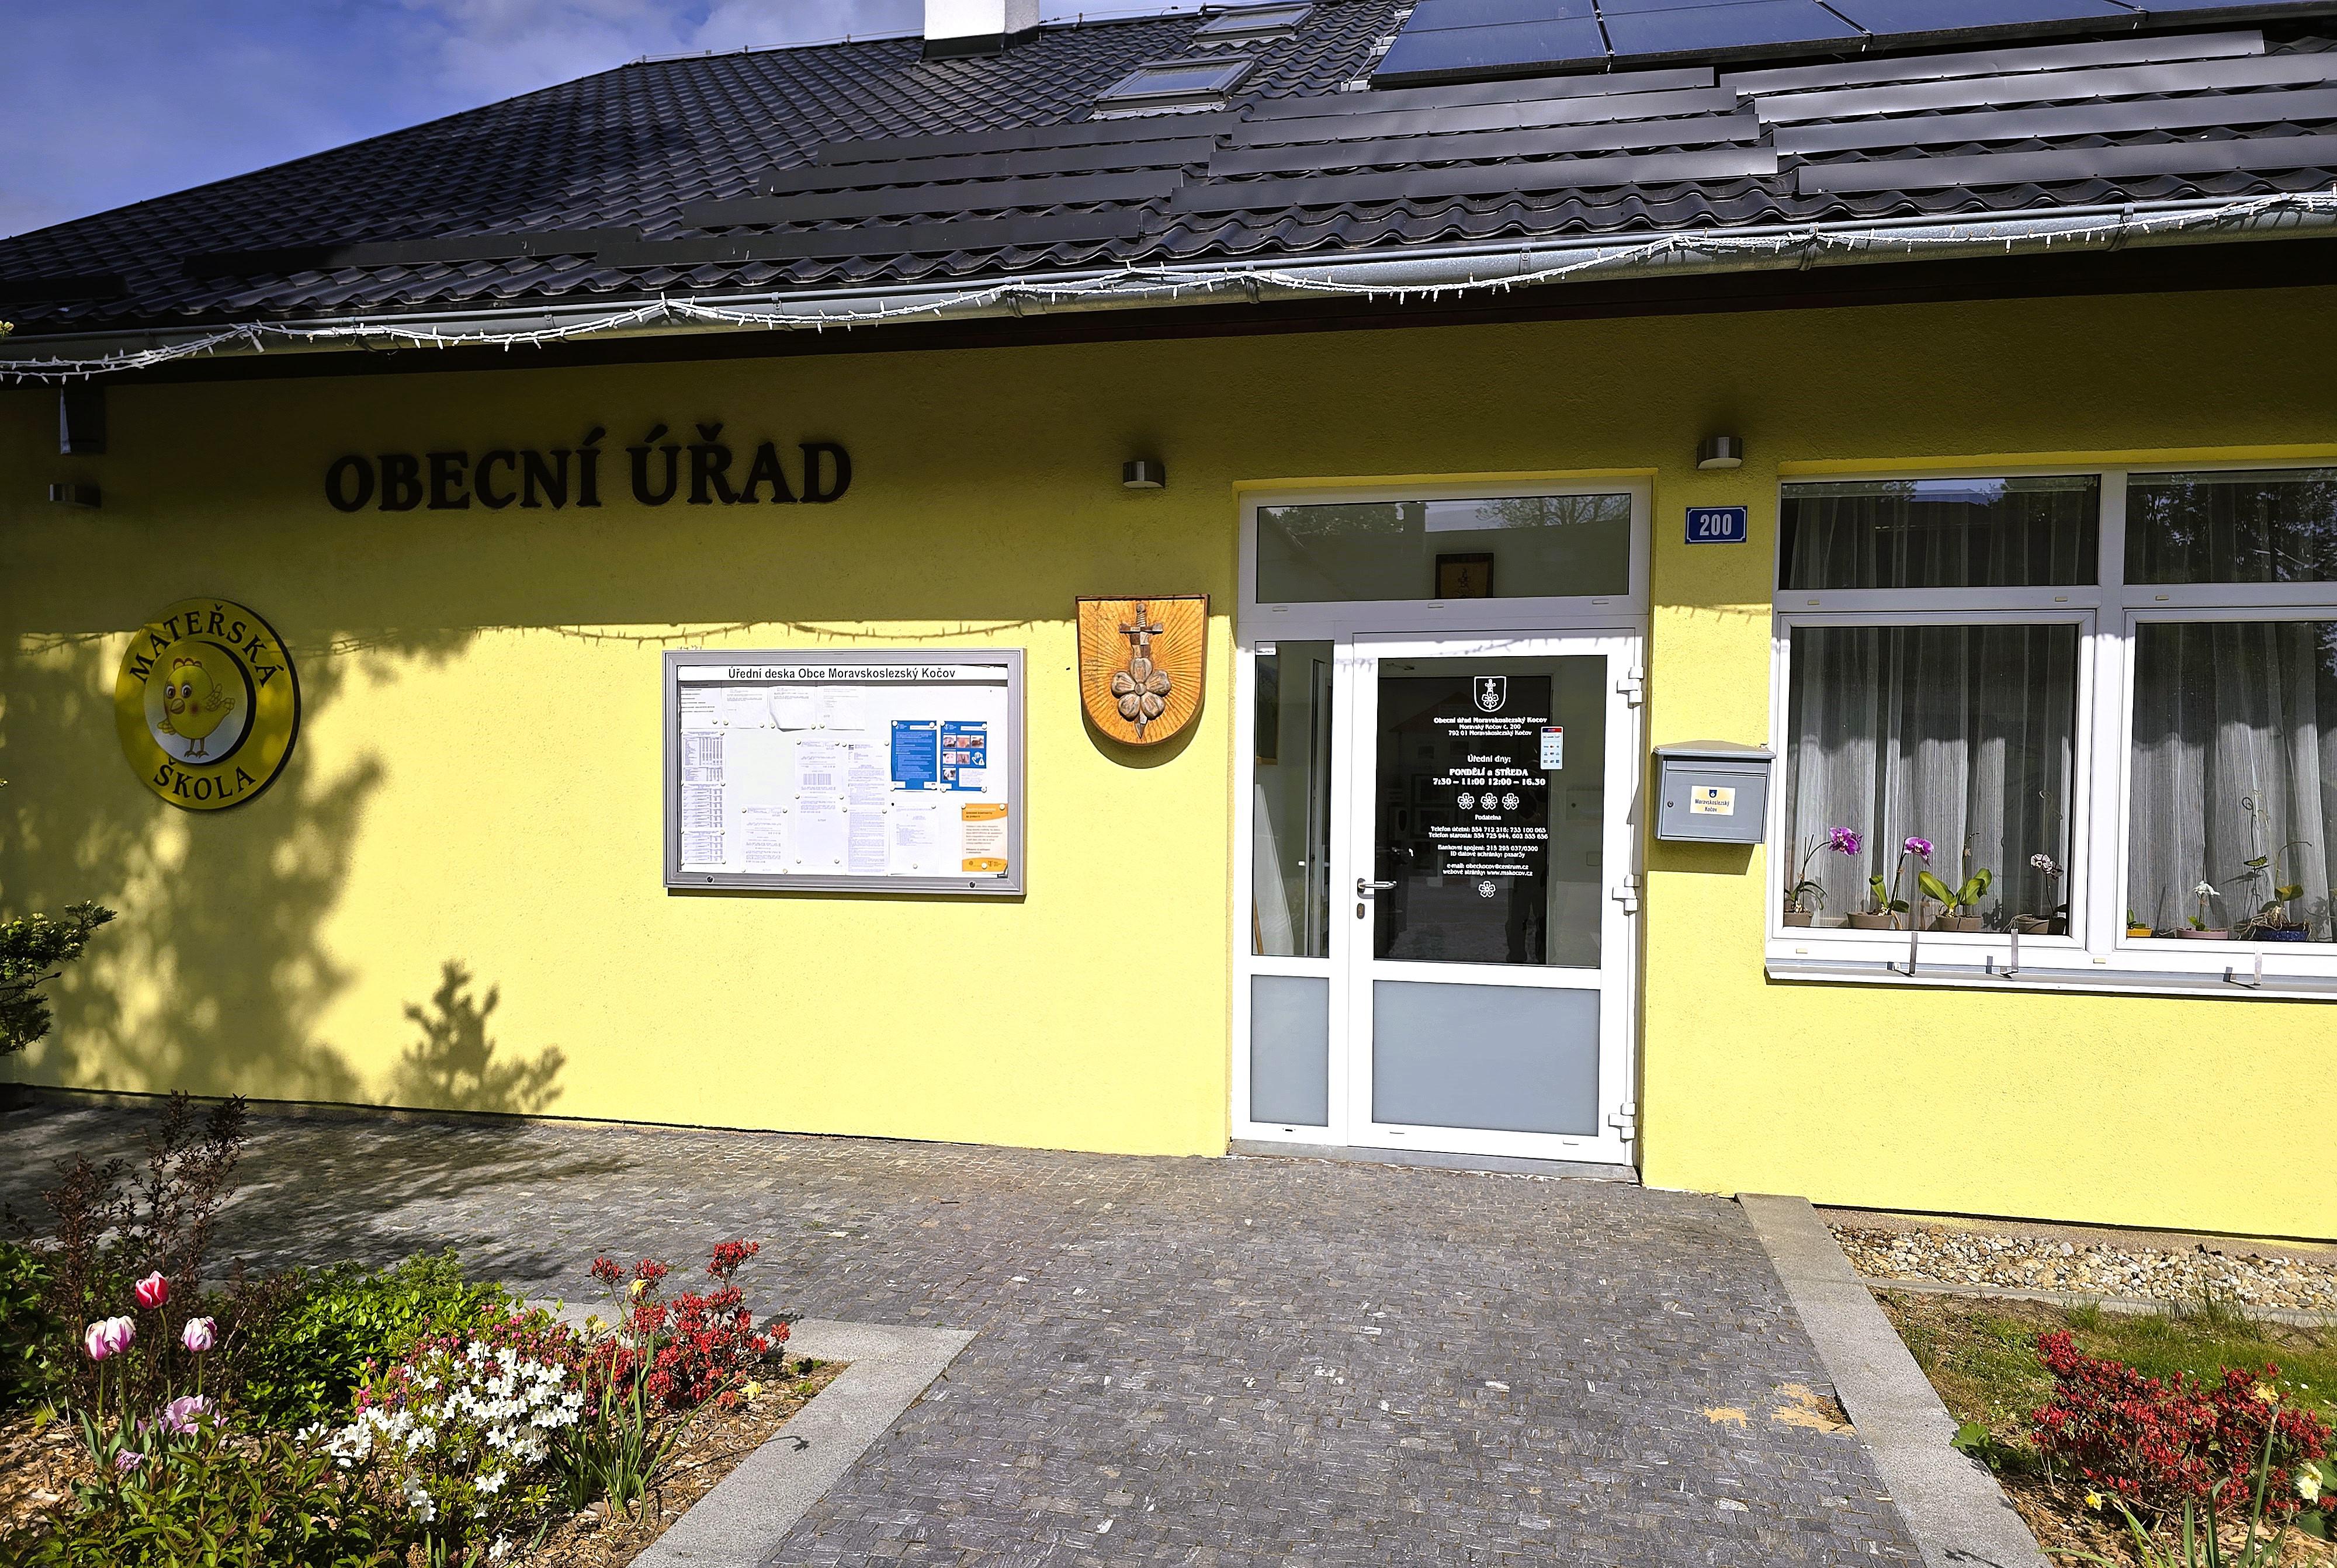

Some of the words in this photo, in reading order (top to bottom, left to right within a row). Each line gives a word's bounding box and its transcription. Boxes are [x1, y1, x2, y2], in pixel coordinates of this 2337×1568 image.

[325, 426, 606, 512] OBECNÍ
[626, 424, 852, 507] ÚŘAD
[1699, 514, 1732, 535] 200
[129, 603, 285, 688] MATEŘSKÁ
[729, 667, 761, 678] Úřední
[765, 669, 795, 678] deska
[799, 668, 824, 678] Obce
[829, 668, 918, 680] Moravskoslezský
[923, 667, 955, 678] Kočov
[1495, 755, 1511, 764] dny:
[153, 758, 256, 801] ŠKOLA
[1450, 767, 1485, 775] PONDĚLÍ
[1495, 768, 1528, 776] STŘEDA
